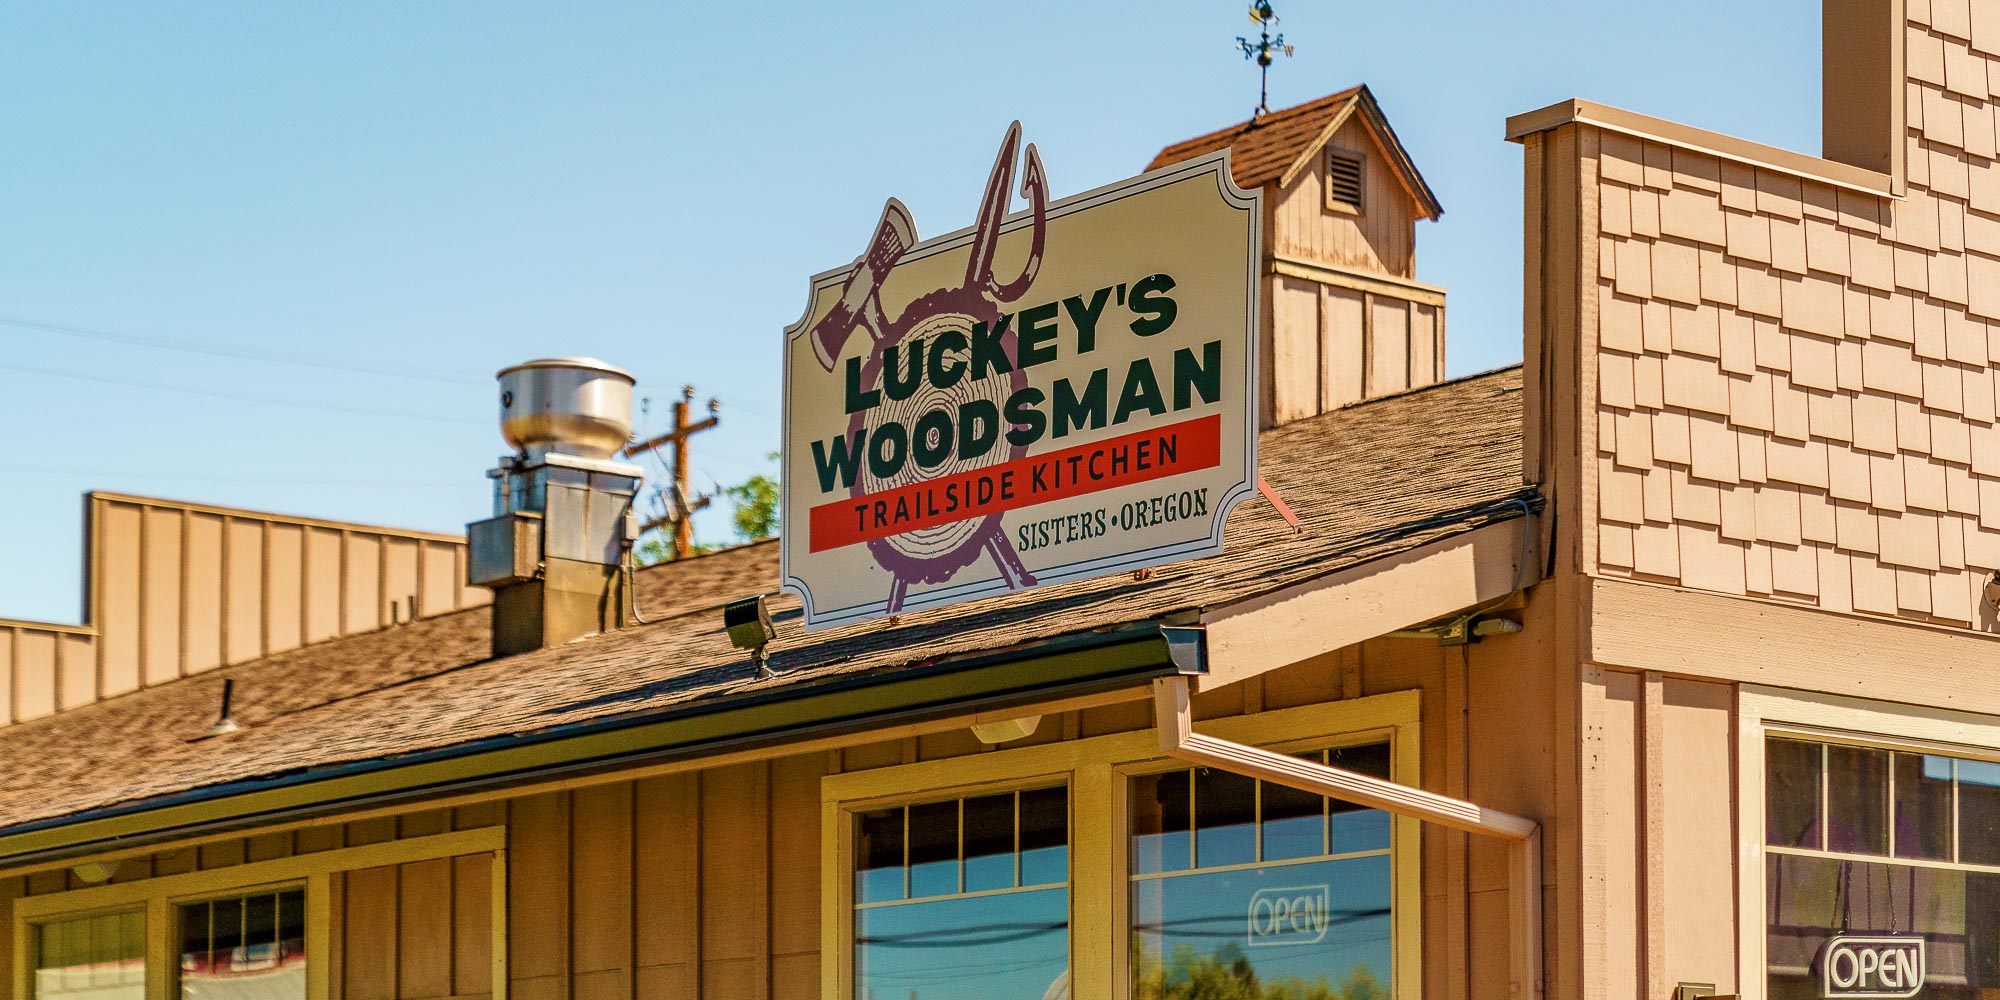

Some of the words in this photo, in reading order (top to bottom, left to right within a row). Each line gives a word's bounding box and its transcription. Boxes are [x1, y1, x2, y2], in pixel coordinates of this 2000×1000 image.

[844, 273, 1178, 415] LUCKEY'S
[810, 340, 1222, 495] WOODSMAN
[856, 470, 1015, 532] TRAILSIDE
[1032, 434, 1178, 494] KITCHEN
[1252, 895, 1323, 936] OPEN
[1830, 948, 1918, 988] OPEN
